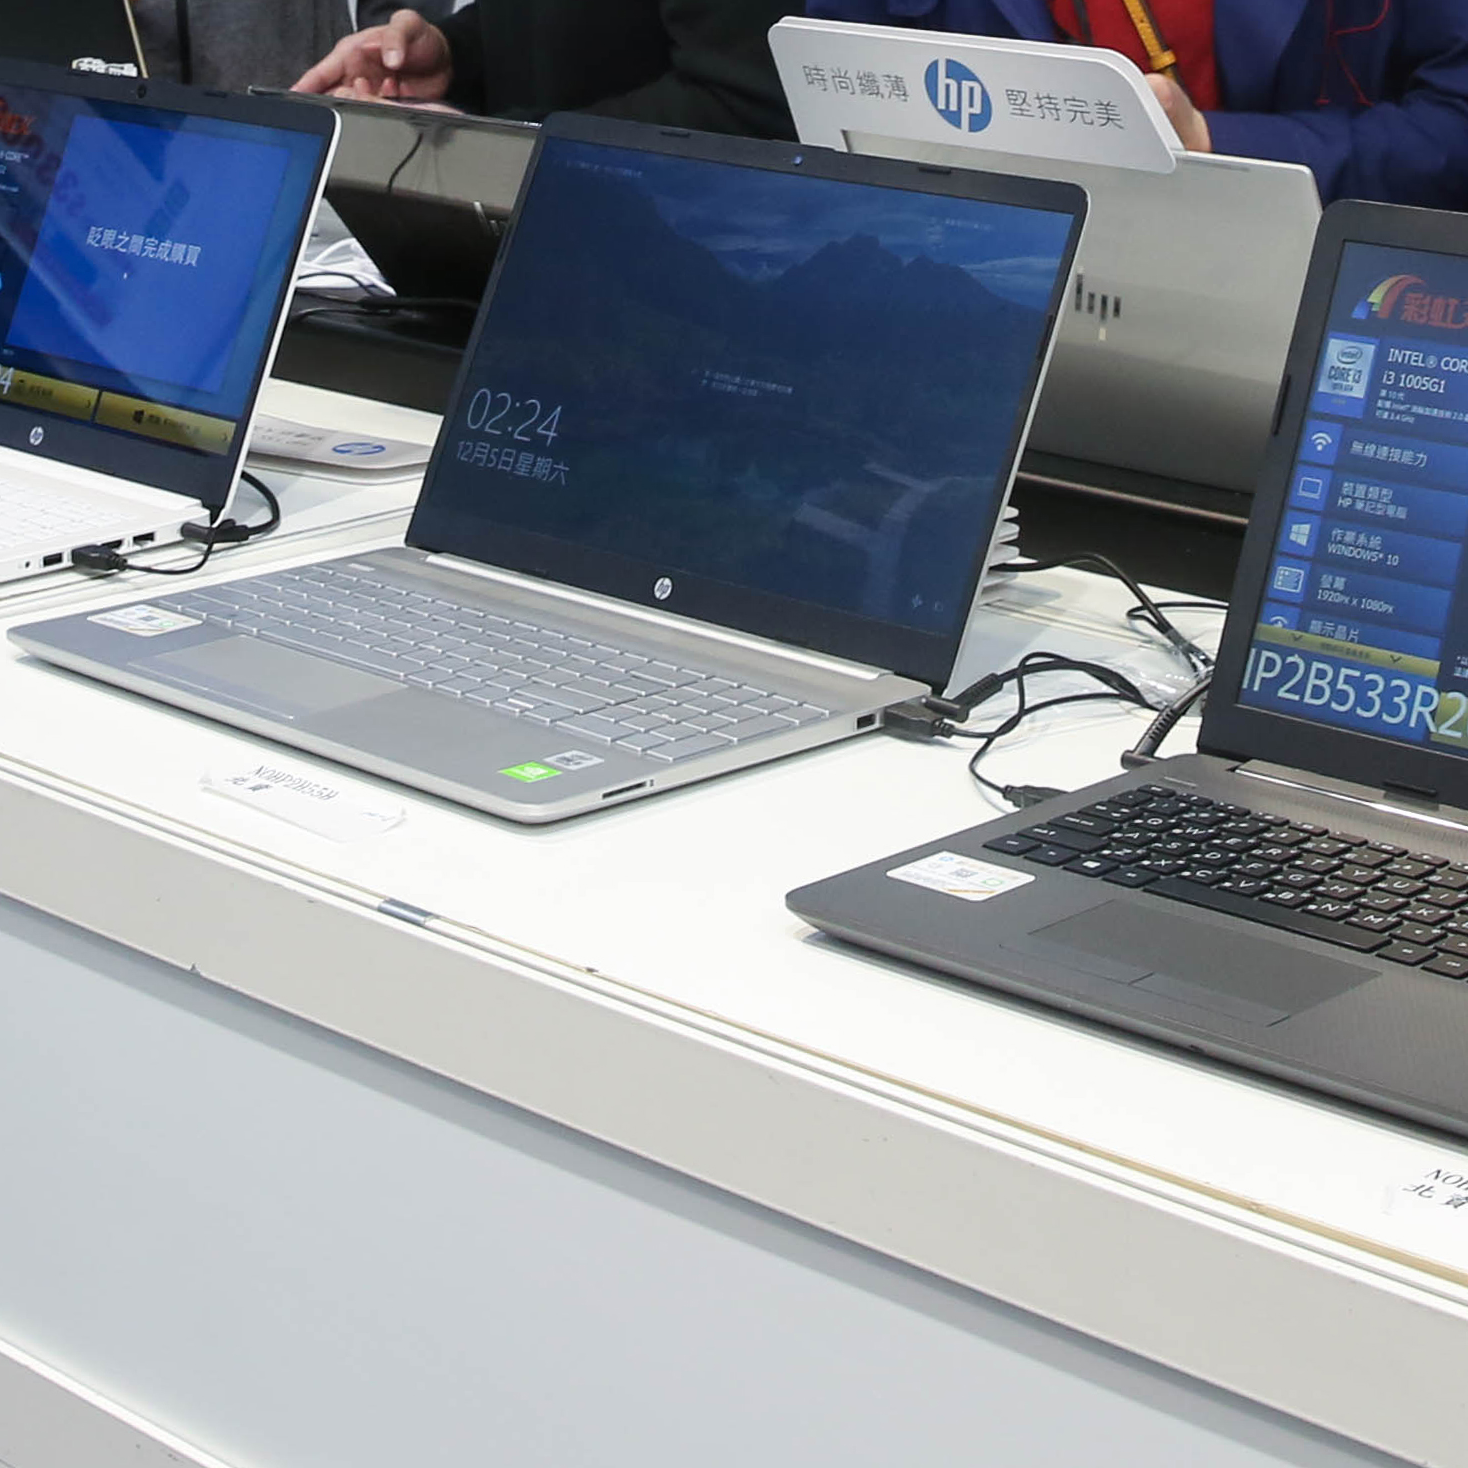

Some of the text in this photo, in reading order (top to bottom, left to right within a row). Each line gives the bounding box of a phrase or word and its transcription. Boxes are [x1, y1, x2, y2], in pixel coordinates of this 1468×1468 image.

[802, 58, 1125, 132] 時尚纖薄 hp 堅持完美
[1383, 371, 1446, 393] i3 1005G1
[466, 388, 564, 448] 02:24
[456, 440, 570, 487] 12月5日星期六
[1350, 441, 1427, 468] 無線連接能力
[1341, 481, 1393, 503] 裝置類型
[1337, 496, 1407, 520] HP 筆記型電腦
[1331, 527, 1382, 551] 作業系統
[1386, 553, 1399, 566] 10
[654, 576, 672, 603] hp
[1309, 620, 1360, 643] 顯示晶片
